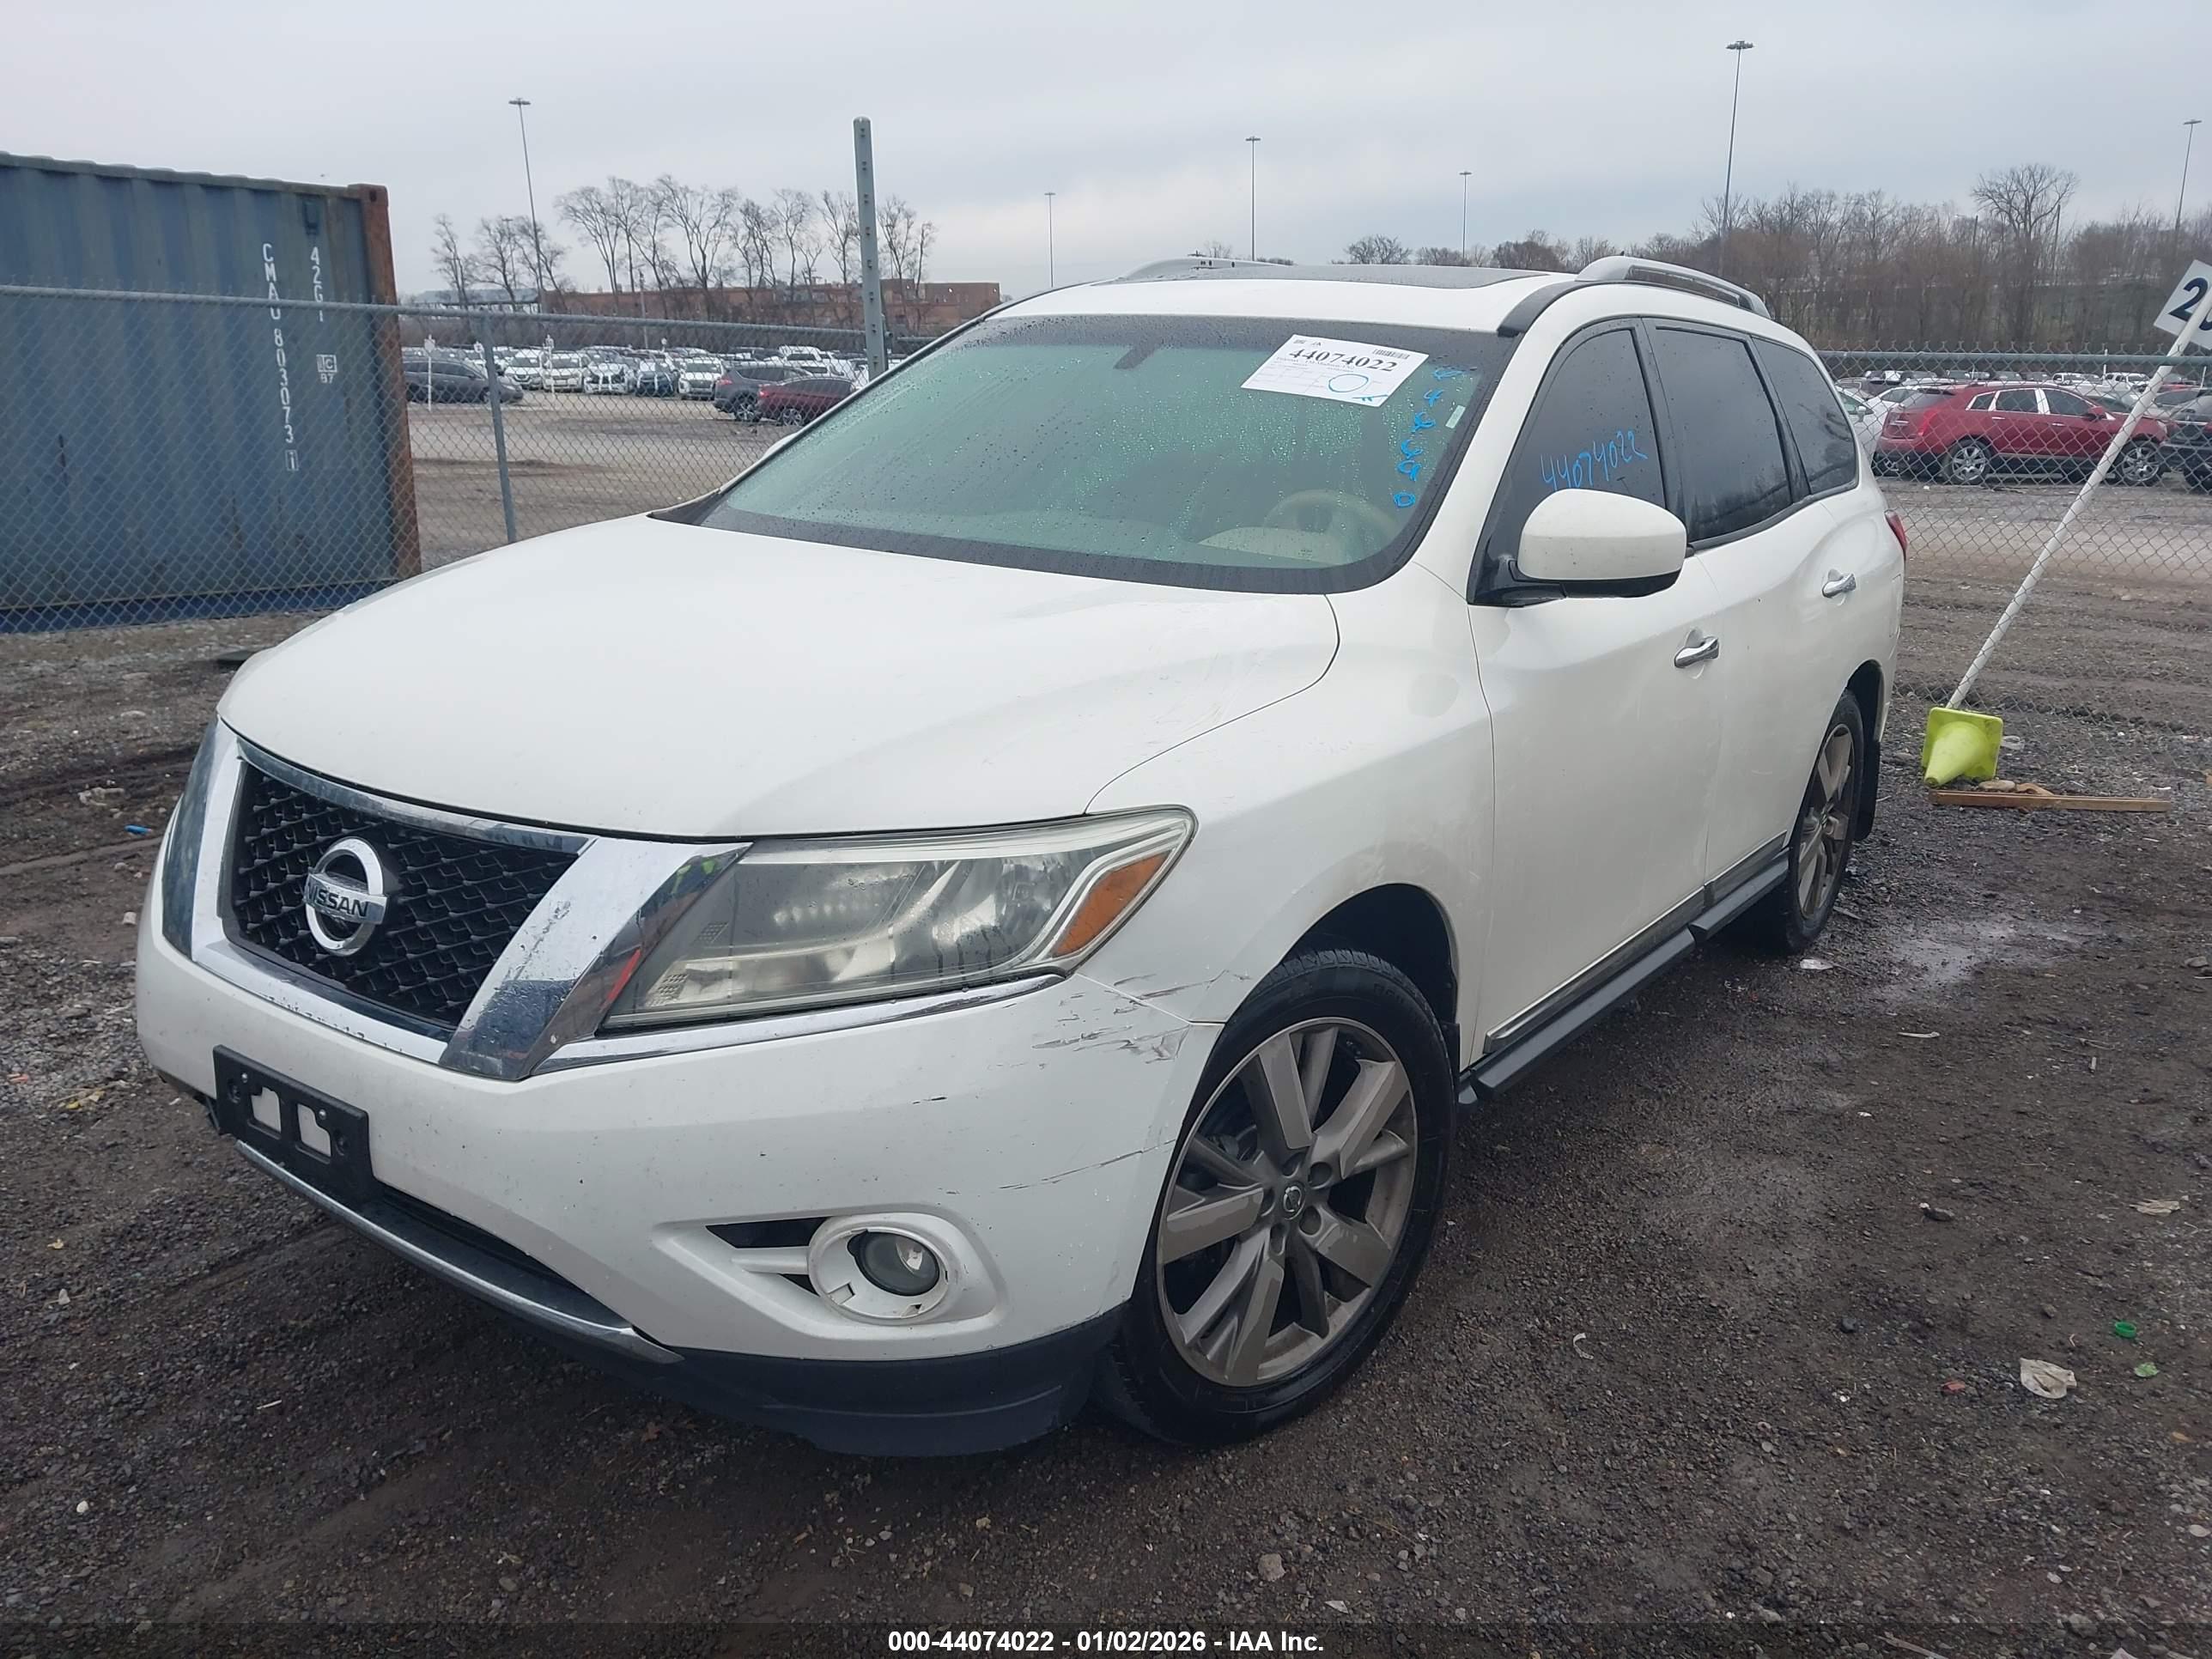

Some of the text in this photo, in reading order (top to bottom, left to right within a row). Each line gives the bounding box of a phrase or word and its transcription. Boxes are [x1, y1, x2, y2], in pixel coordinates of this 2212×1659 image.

[262, 243, 281, 319] CMAU
[273, 329, 294, 443] 803073
[1289, 349, 1398, 372] 44074022
[1540, 430, 1648, 492] 44074022
[305, 881, 369, 917] NISSAN
